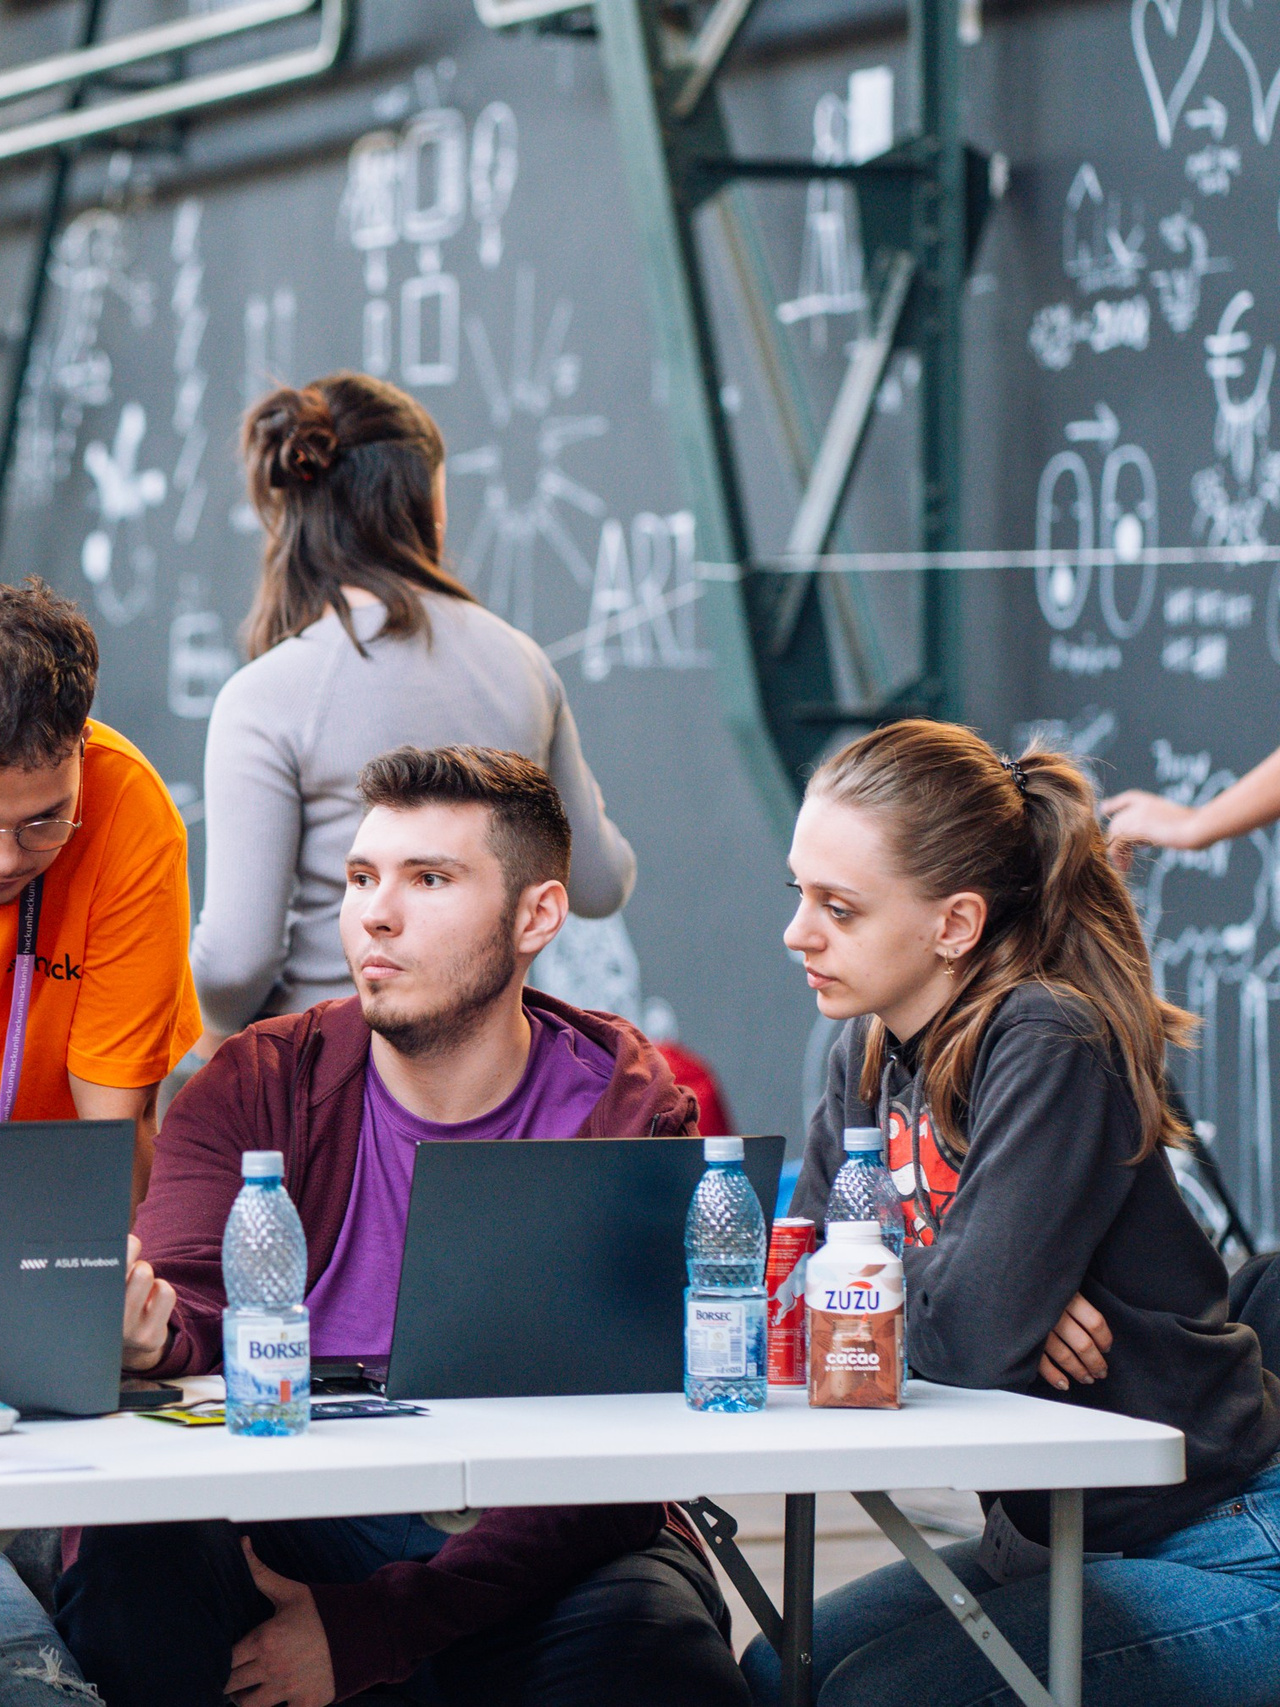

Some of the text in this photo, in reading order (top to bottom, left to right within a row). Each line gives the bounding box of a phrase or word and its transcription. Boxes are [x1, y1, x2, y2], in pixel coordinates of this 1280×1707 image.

[54, 1258, 79, 1268] ASUS
[825, 1290, 880, 1310] ZUZU
[825, 1353, 880, 1365] cacao
